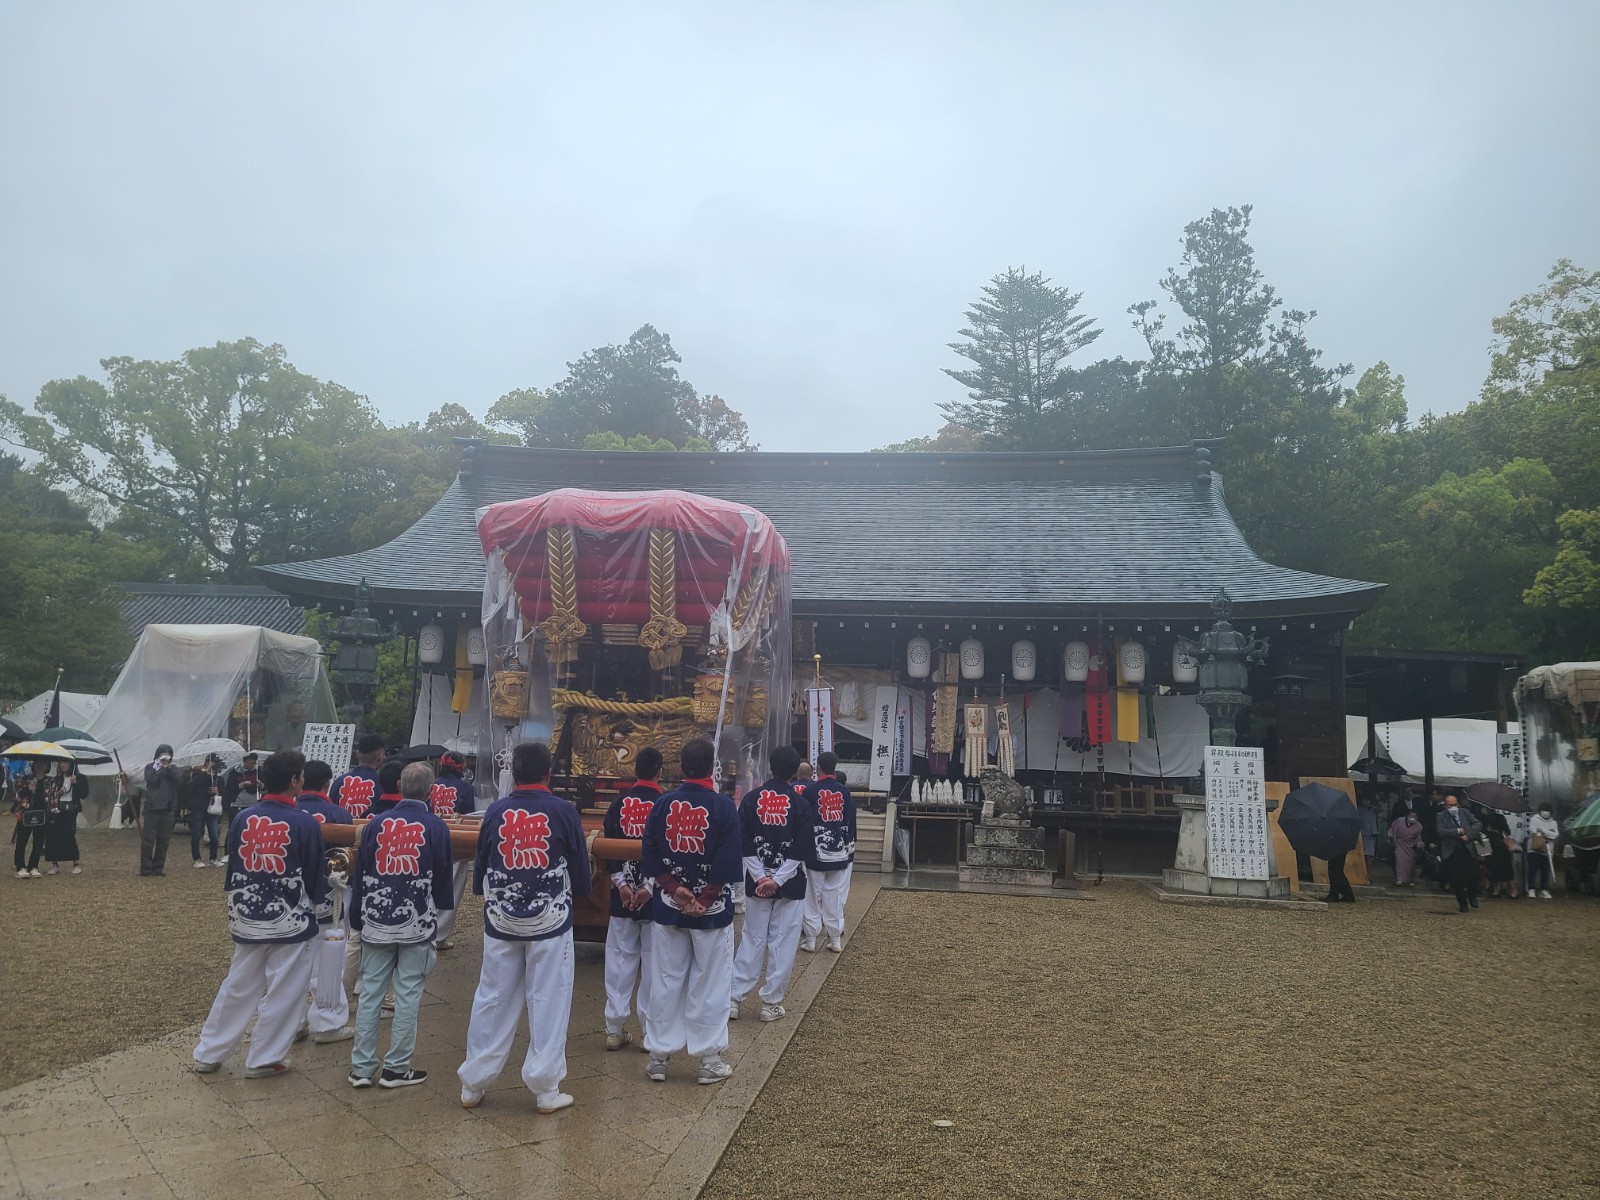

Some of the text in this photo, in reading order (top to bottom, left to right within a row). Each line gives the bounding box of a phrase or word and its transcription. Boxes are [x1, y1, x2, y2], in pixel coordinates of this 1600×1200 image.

[333, 736, 350, 744] 女性
[1445, 751, 1471, 764] 宮
[339, 775, 376, 817] 撫
[620, 796, 654, 838] 撫
[756, 789, 791, 827] 撫
[817, 789, 845, 822] 撫
[239, 814, 291, 875] 撫
[375, 817, 426, 876] 撫
[497, 808, 552, 870] 撫
[665, 799, 710, 855] 撫
